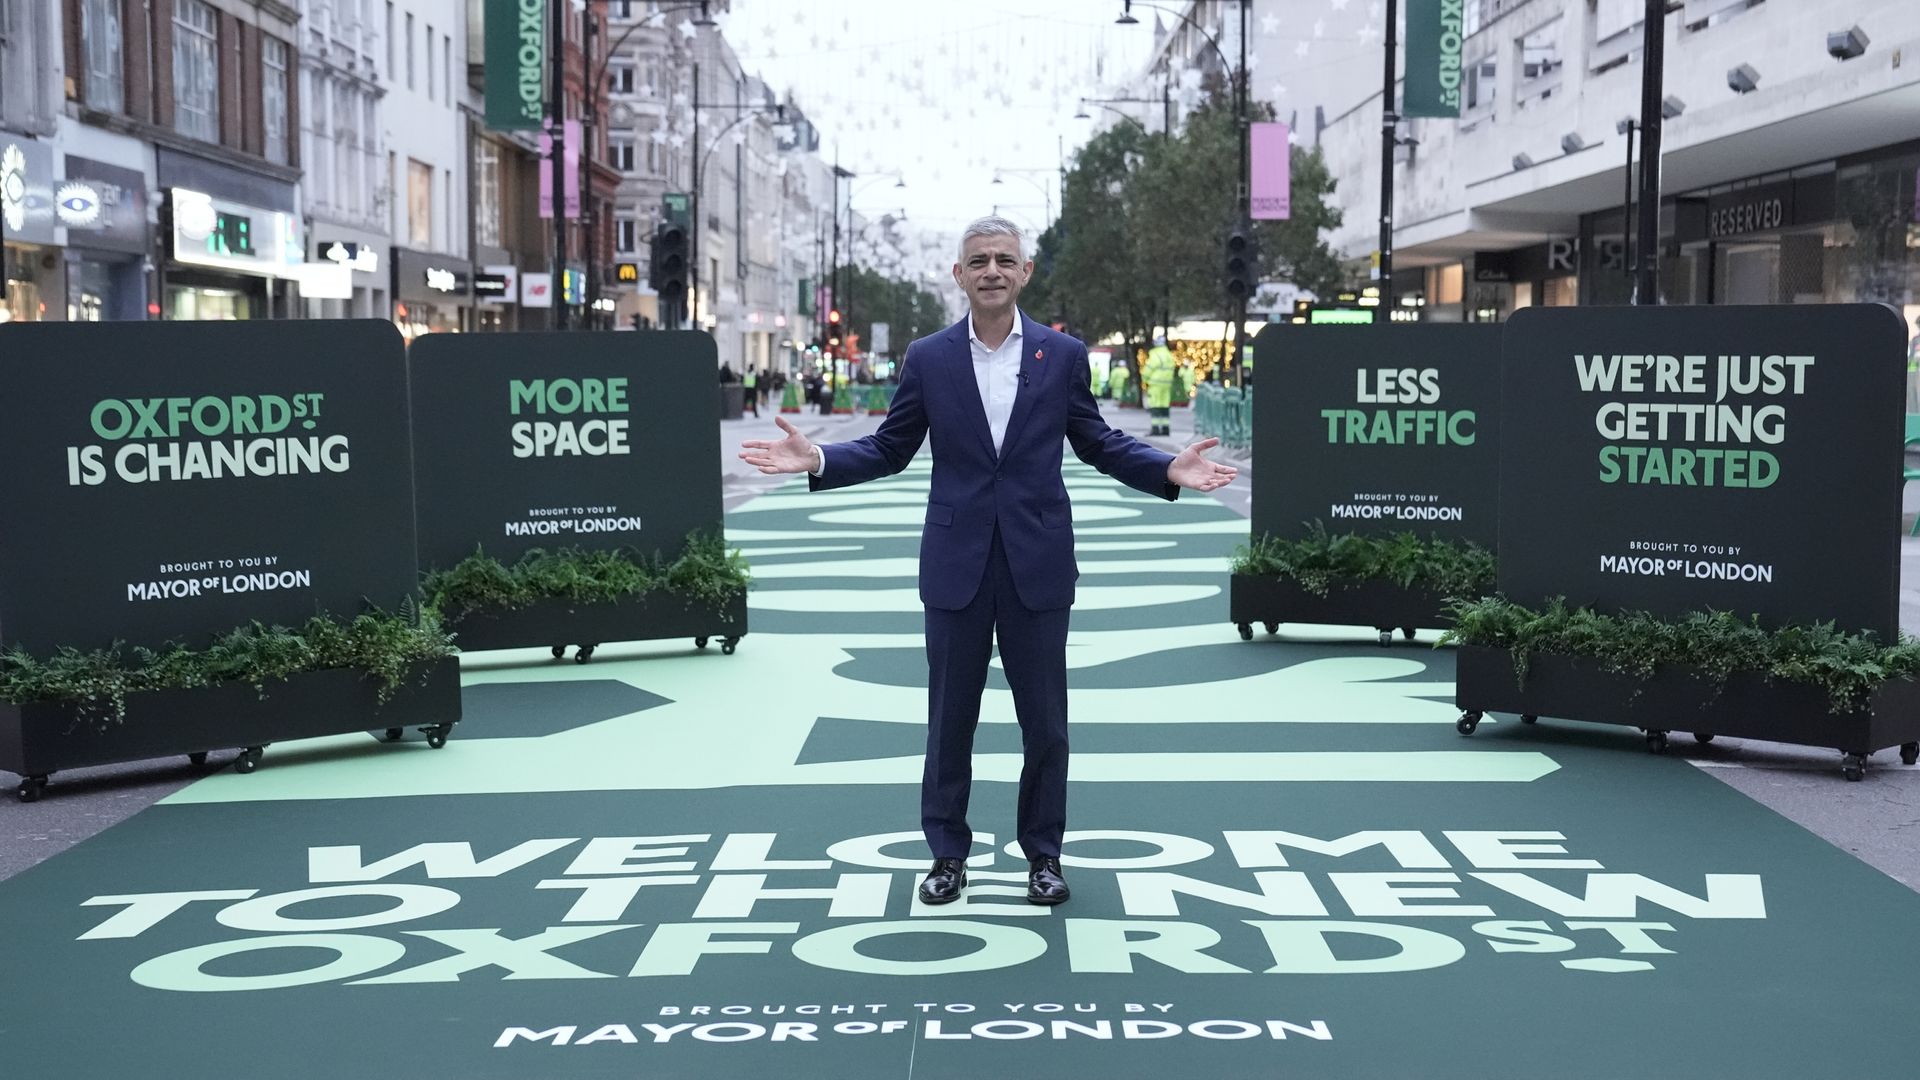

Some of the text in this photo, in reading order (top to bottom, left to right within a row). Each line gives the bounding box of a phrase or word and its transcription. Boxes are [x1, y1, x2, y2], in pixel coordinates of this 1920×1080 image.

[1439, 0, 1462, 90] XFORD
[1711, 198, 1782, 236] RESERVED
[510, 378, 629, 415] MORE
[1357, 368, 1440, 404] LESS
[1574, 354, 1815, 403] WE'RE JUST
[90, 394, 292, 440] OXFORD
[1321, 409, 1476, 446] TRAFFIC
[1595, 402, 1786, 445] GETTING
[511, 419, 630, 458] SPACE
[67, 435, 350, 485] IS CHANGING
[1599, 445, 1780, 489] STARTED
[529, 506, 617, 517] BROUGHT TO YOU BY
[1331, 504, 1462, 521] MAYOR OF LONDON
[1354, 493, 1439, 503] BROUGHT TO YOU BY
[505, 516, 641, 536] MAYOR OF LONDON
[159, 556, 278, 574] BROUGHT TO YOU BY
[1629, 540, 1741, 556] BROUGHT TO YOU BY
[127, 569, 310, 601] MAYOR OF LONDON
[1600, 555, 1772, 583] MAYOR OF LONDON
[308, 829, 1605, 883] WELCOME
[75, 870, 1767, 940] TO THE NEW
[130, 919, 1467, 992] OXFORD
[659, 1002, 1175, 1017] BROUGHT TO YOU BY
[493, 1019, 1334, 1047] MAYOR OF LONDON
